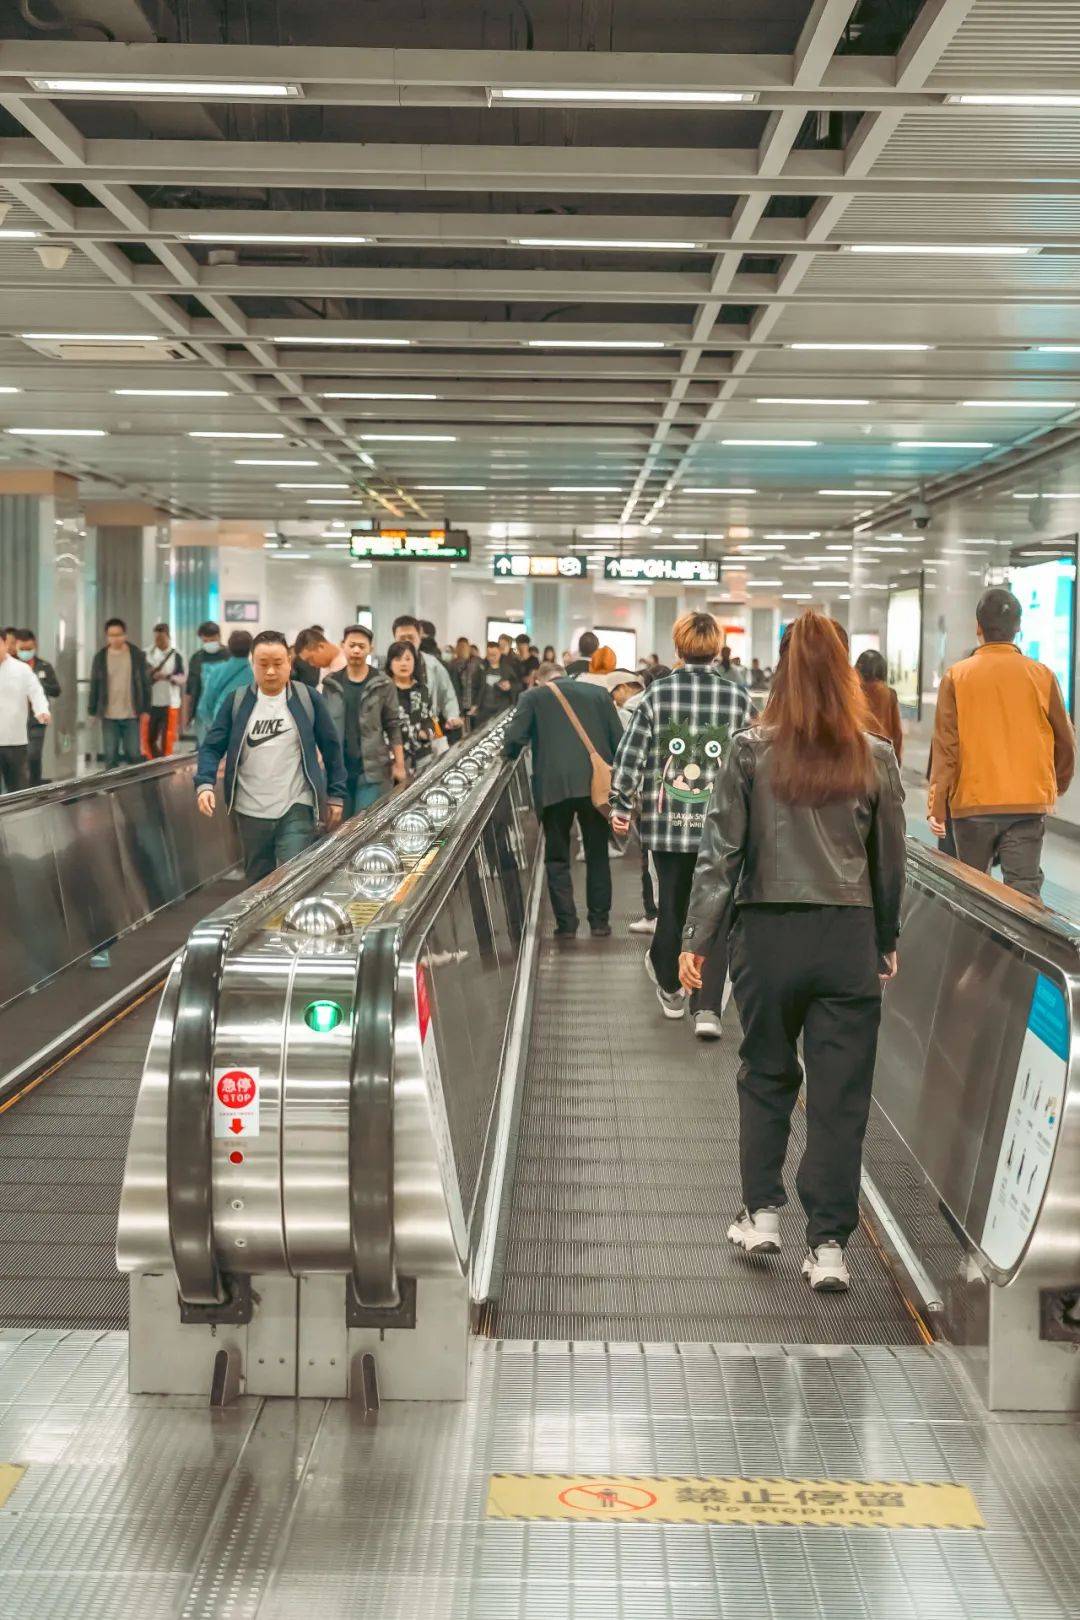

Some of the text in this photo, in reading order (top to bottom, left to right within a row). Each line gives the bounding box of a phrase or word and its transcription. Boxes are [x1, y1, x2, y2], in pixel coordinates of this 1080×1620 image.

[251, 718, 284, 734] NIKE
[690, 821, 704, 829] WHIL
[222, 1093, 251, 1102] STOP
[675, 1487, 905, 1507] 禁止停留
[703, 1505, 883, 1517] No Stopping
